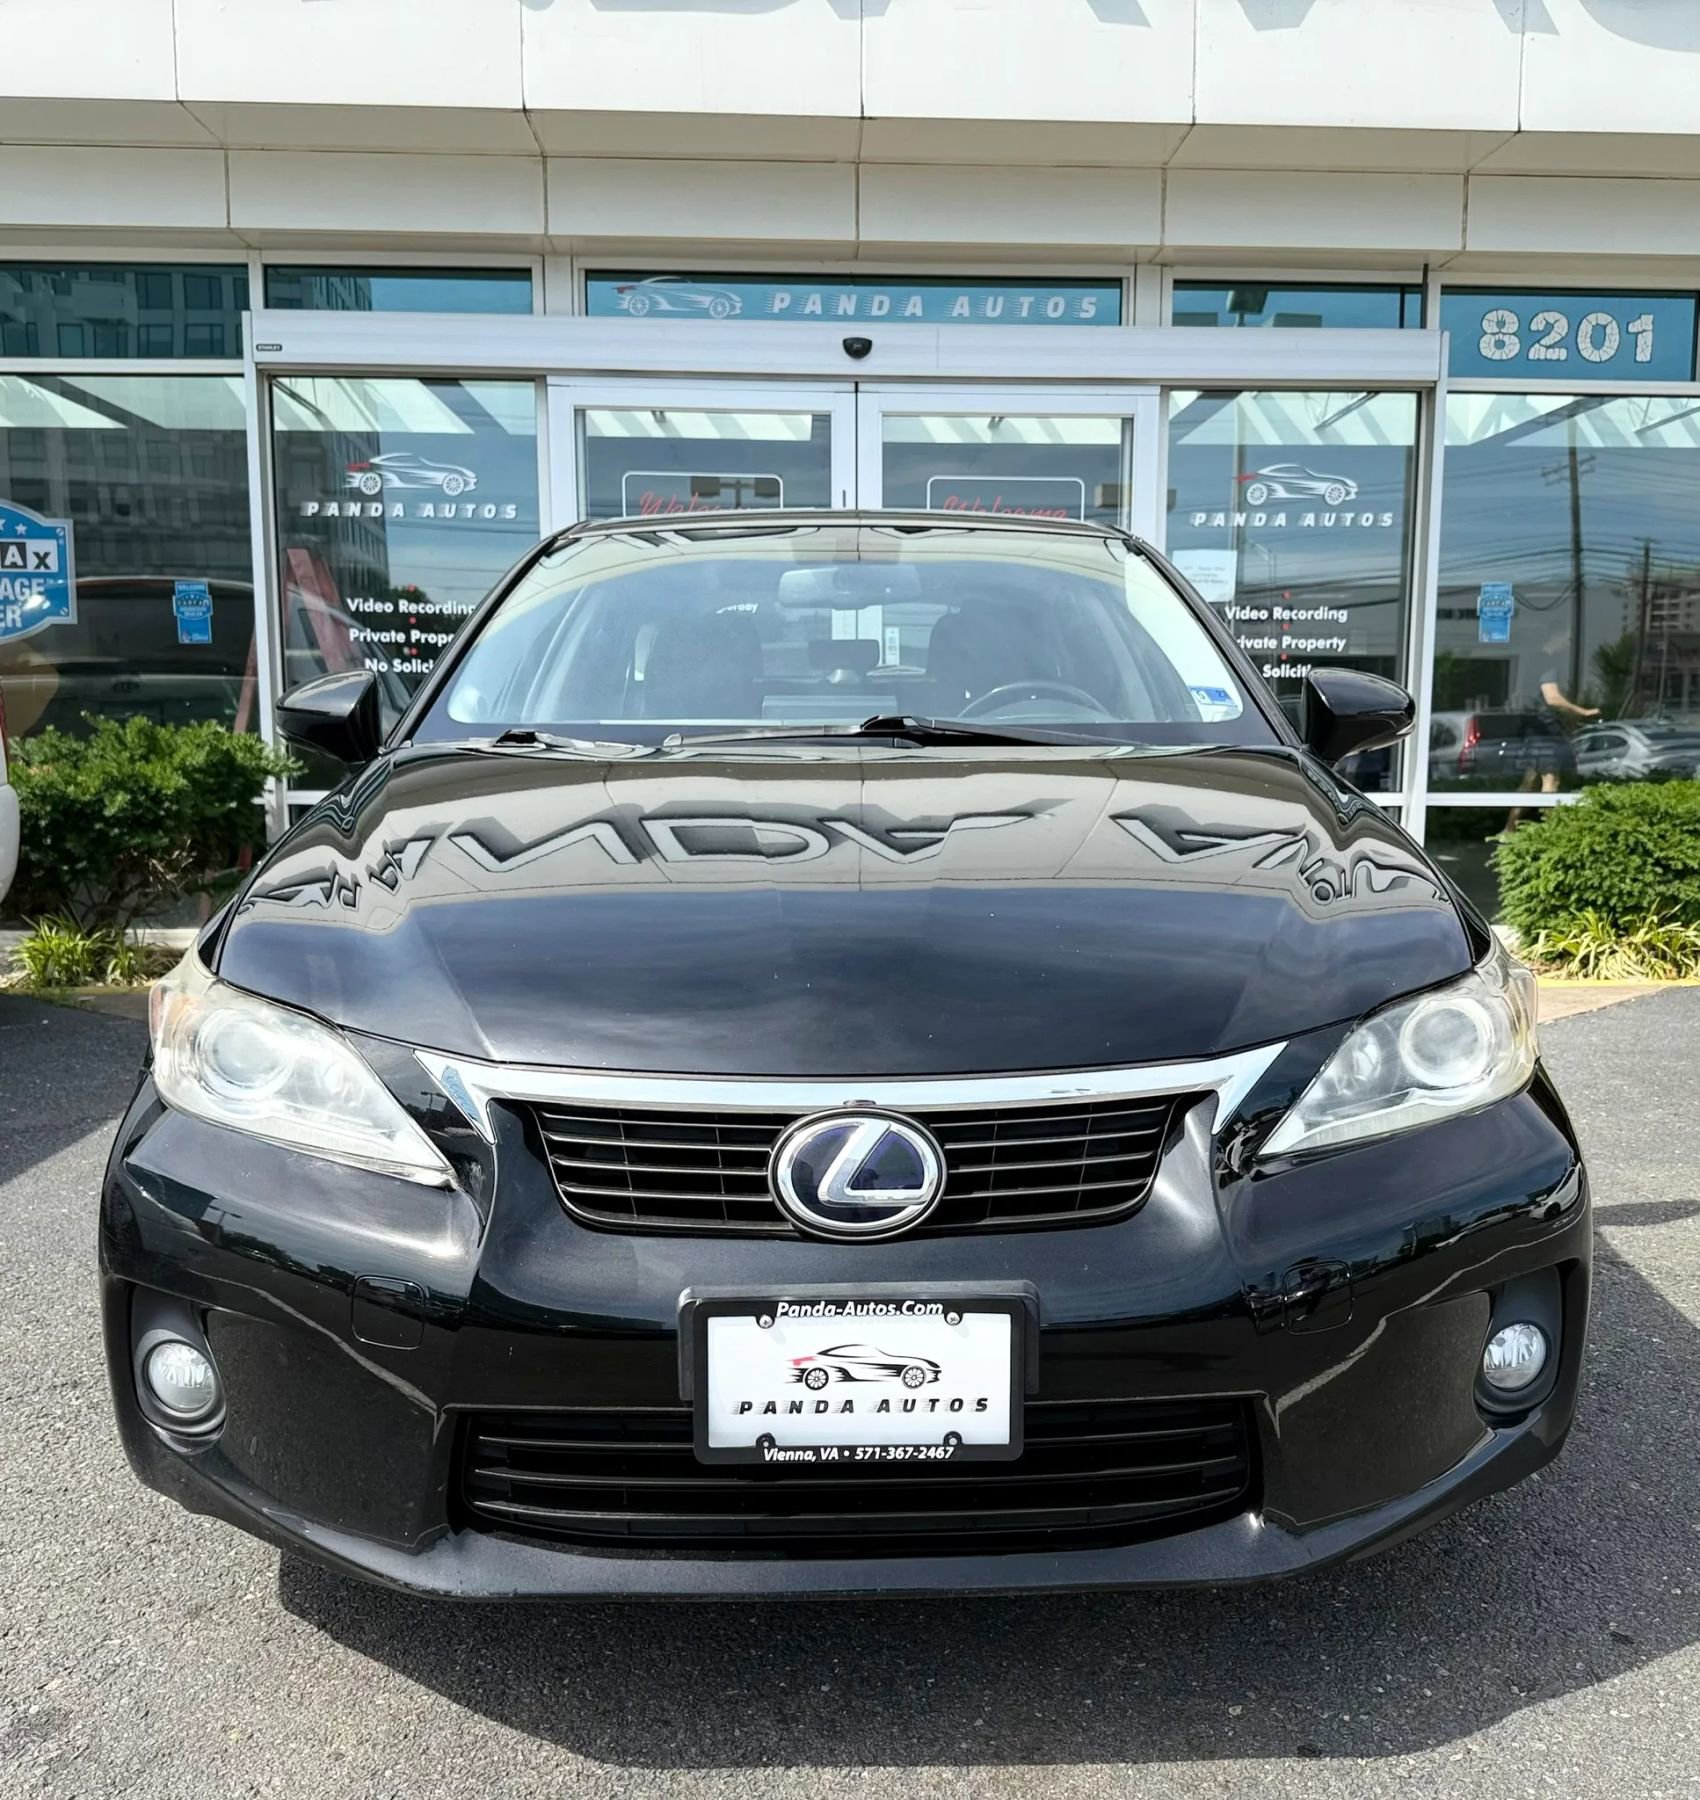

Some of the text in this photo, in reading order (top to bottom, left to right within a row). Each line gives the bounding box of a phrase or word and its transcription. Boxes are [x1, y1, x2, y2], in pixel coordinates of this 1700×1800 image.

[766, 292, 1097, 319] PANDA AUTOS
[1479, 308, 1655, 363] 8201
[303, 501, 518, 520] PANDA AUTOS
[1191, 511, 1394, 528] PANDA AUTOS
[346, 598, 394, 613] Video
[1225, 605, 1348, 624] Video Recording
[349, 628, 406, 643] Private
[1282, 635, 1348, 653] Property
[364, 658, 389, 673] No
[776, 1300, 944, 1318] Panda-Autos.Com
[734, 1397, 989, 1416] PANDA AUTOS
[763, 1446, 956, 1463] Vienna, VA 571-367-2467
